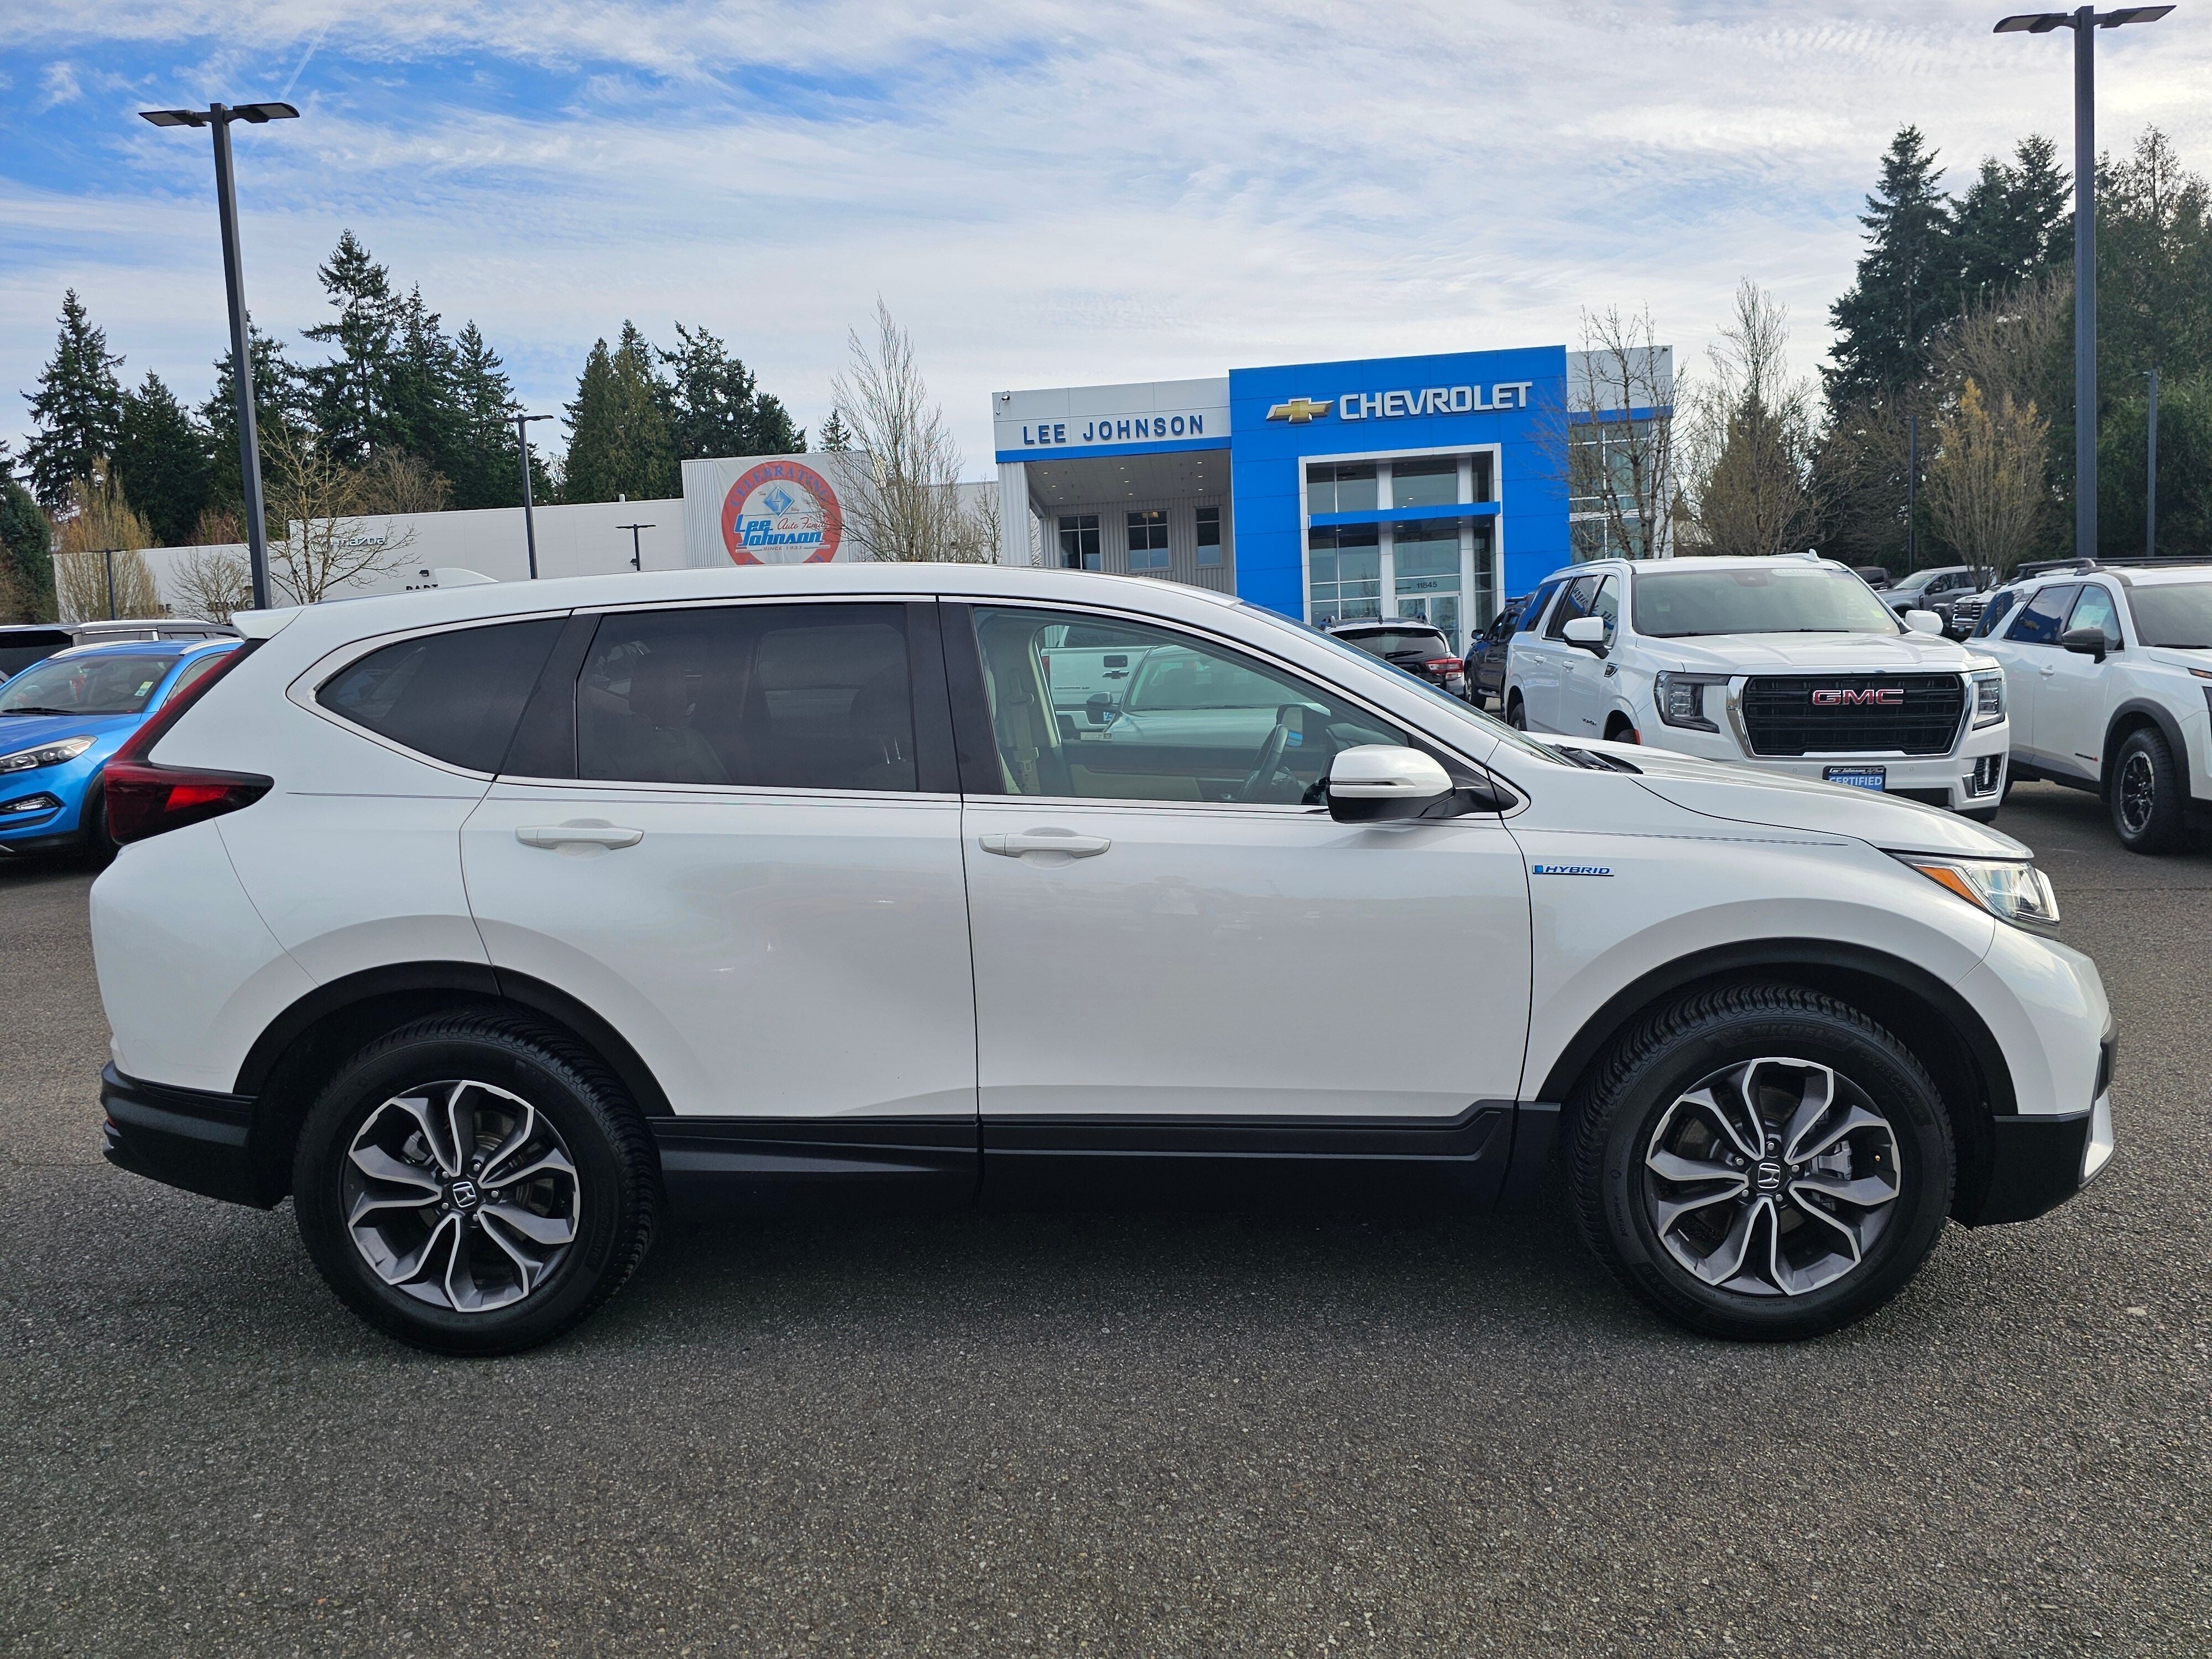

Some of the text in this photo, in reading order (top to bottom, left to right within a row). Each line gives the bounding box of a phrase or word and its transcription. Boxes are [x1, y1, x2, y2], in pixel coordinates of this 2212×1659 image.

[1339, 382, 1533, 420] CHEVROLET
[1023, 415, 1203, 445] LEE JOHNSON
[734, 514, 774, 533] Lee
[778, 518, 799, 530] Auto
[737, 526, 824, 546] Johnson
[1813, 689, 1904, 706] GMC
[1545, 866, 1610, 874] HYBRID
